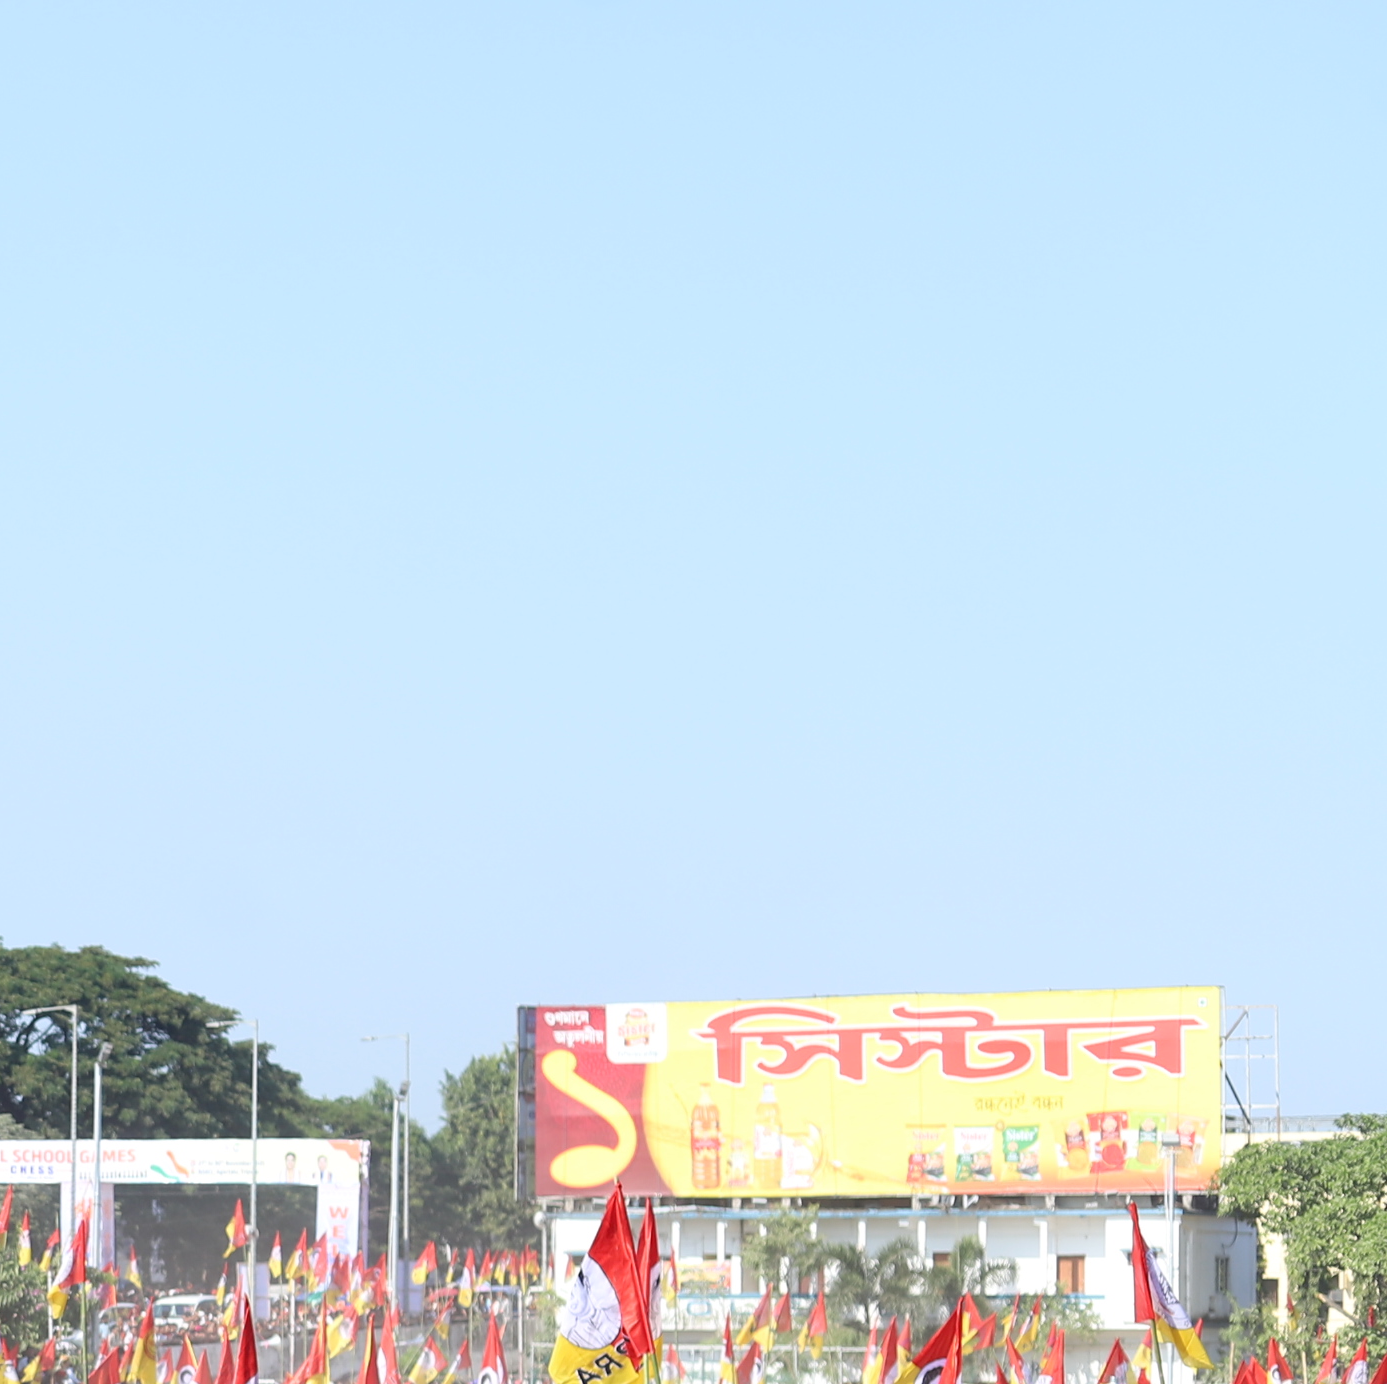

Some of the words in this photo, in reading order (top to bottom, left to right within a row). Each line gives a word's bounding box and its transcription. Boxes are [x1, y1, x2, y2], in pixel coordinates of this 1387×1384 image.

[695, 1004, 1208, 1086] সিস্টার
[13, 1148, 74, 1164] SCHOOL
[10, 1165, 55, 1175] CHESS
